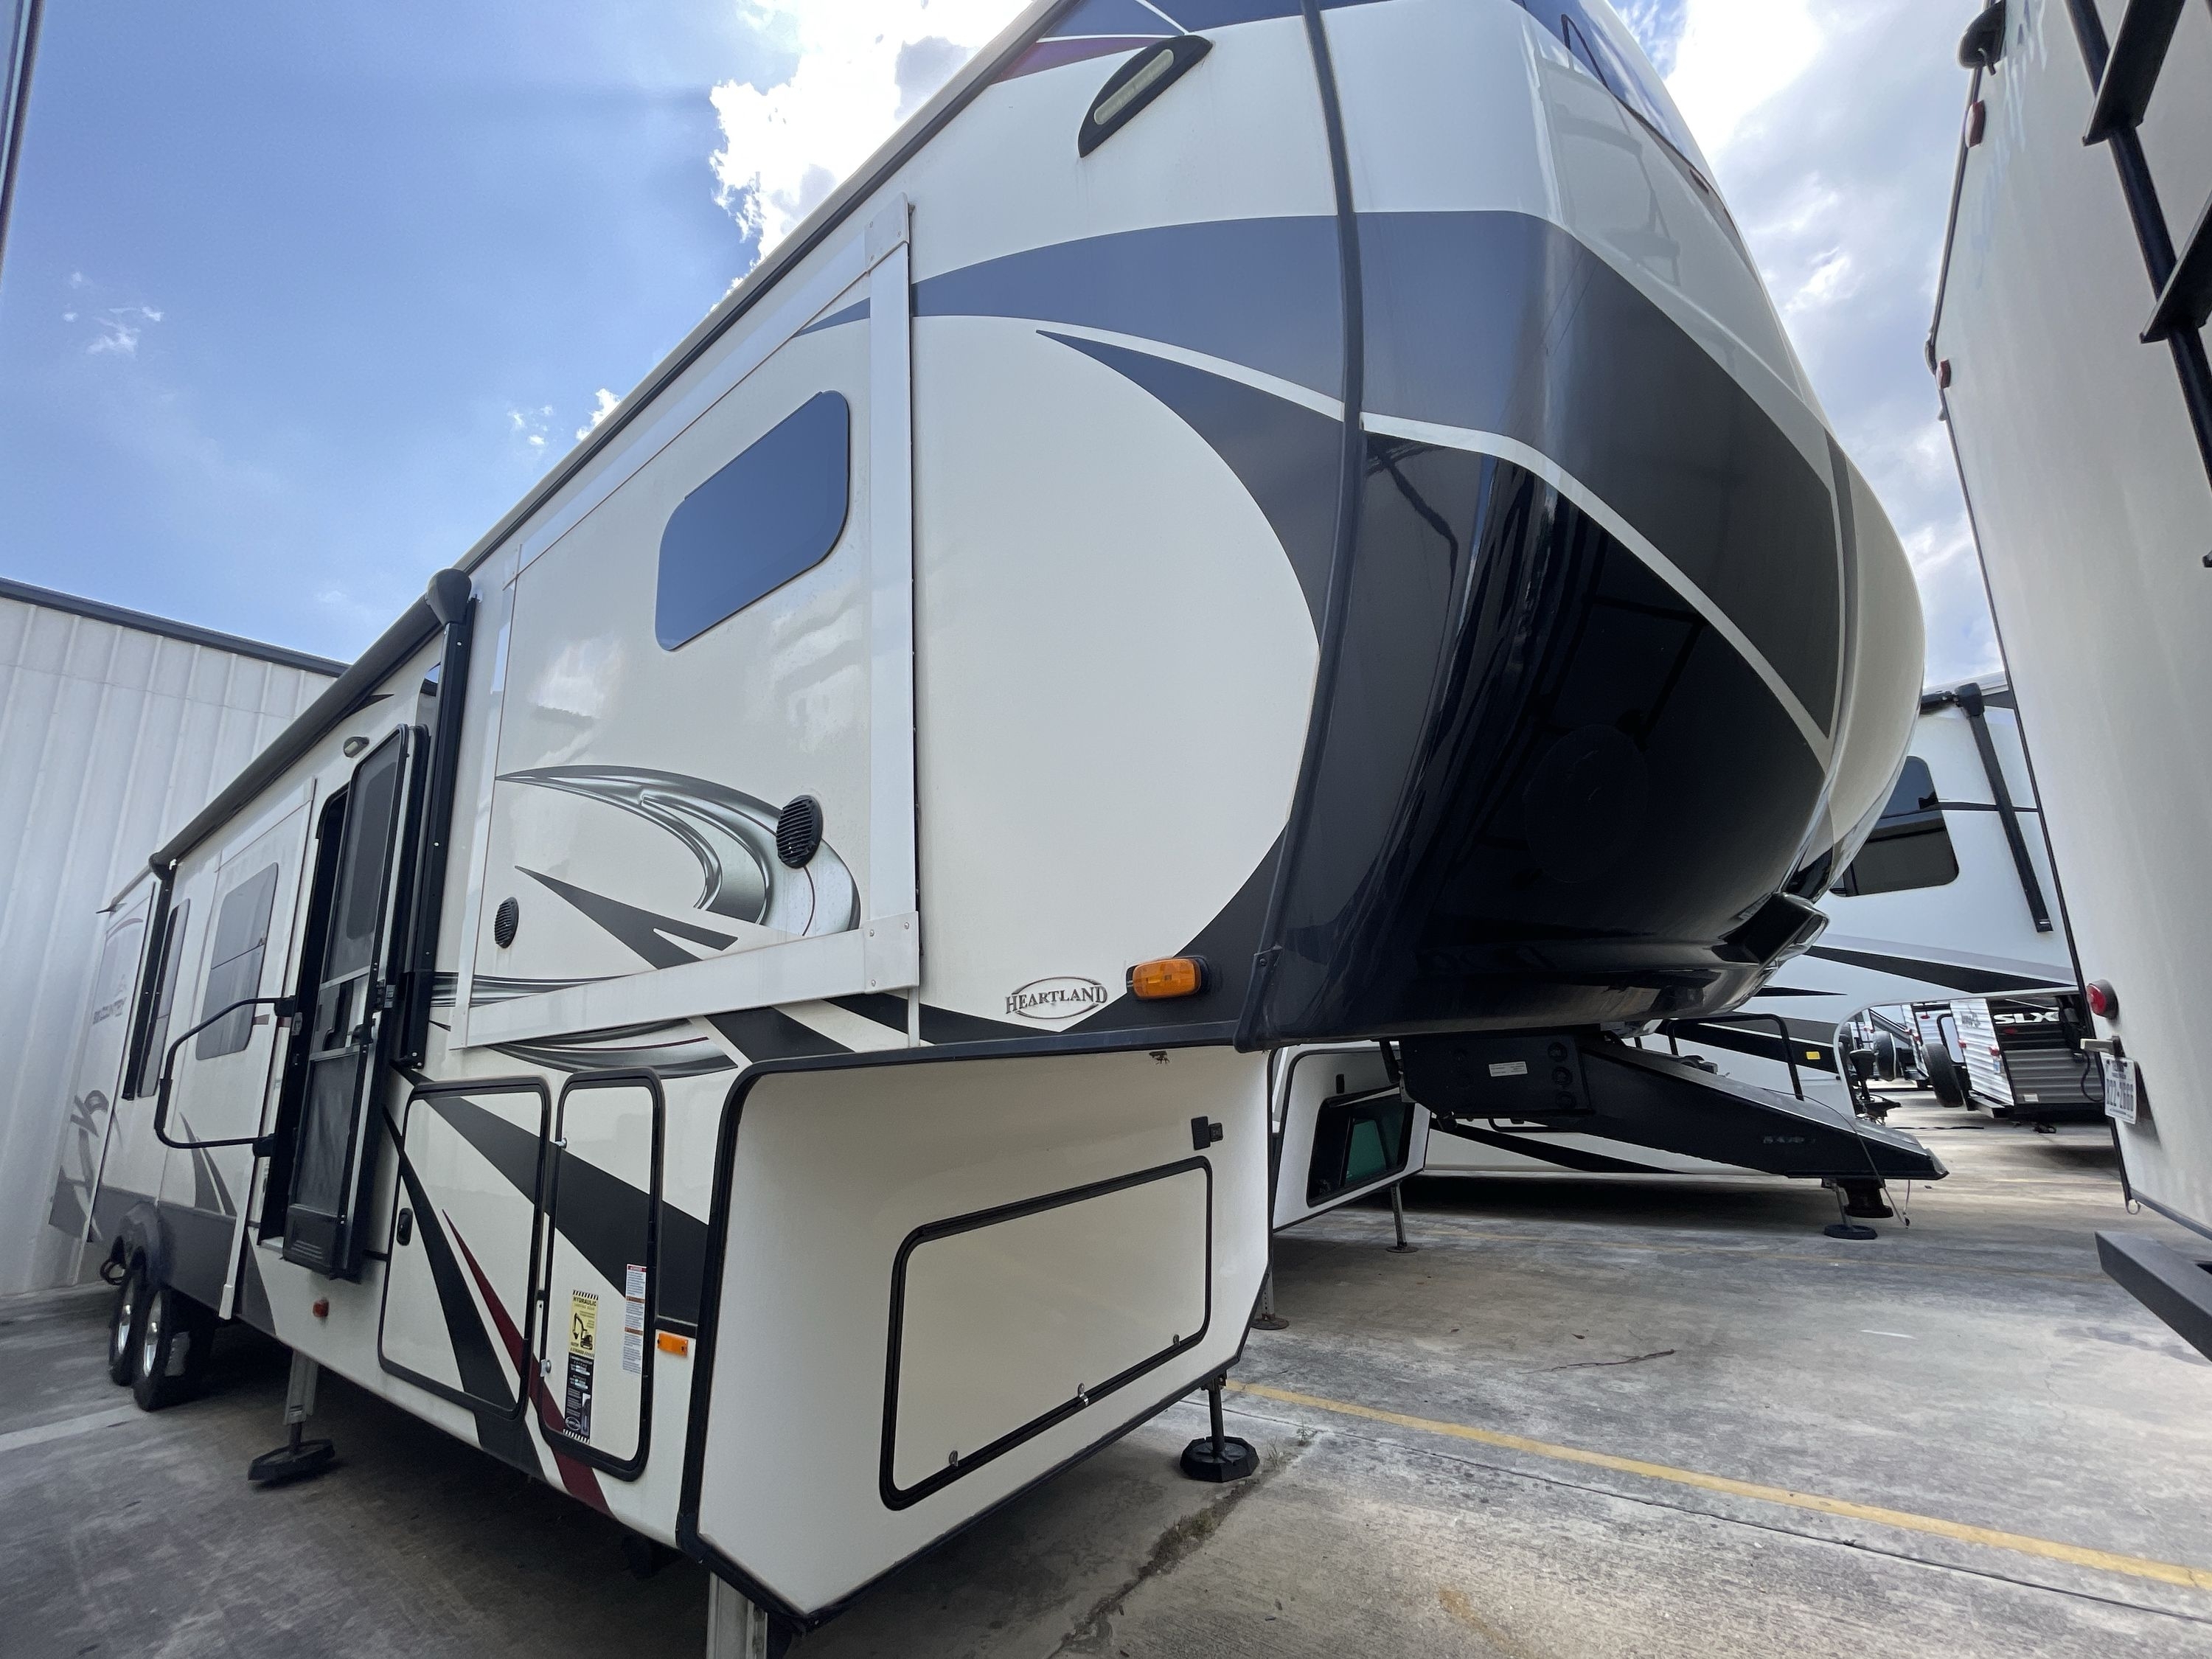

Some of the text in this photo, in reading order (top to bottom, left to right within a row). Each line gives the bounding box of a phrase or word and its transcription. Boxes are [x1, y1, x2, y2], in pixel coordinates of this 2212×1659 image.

[1005, 985, 1108, 1014] HEARTLAND
[1994, 1012, 2060, 1024] SLX
[573, 1296, 597, 1307] HYDRAULIC
